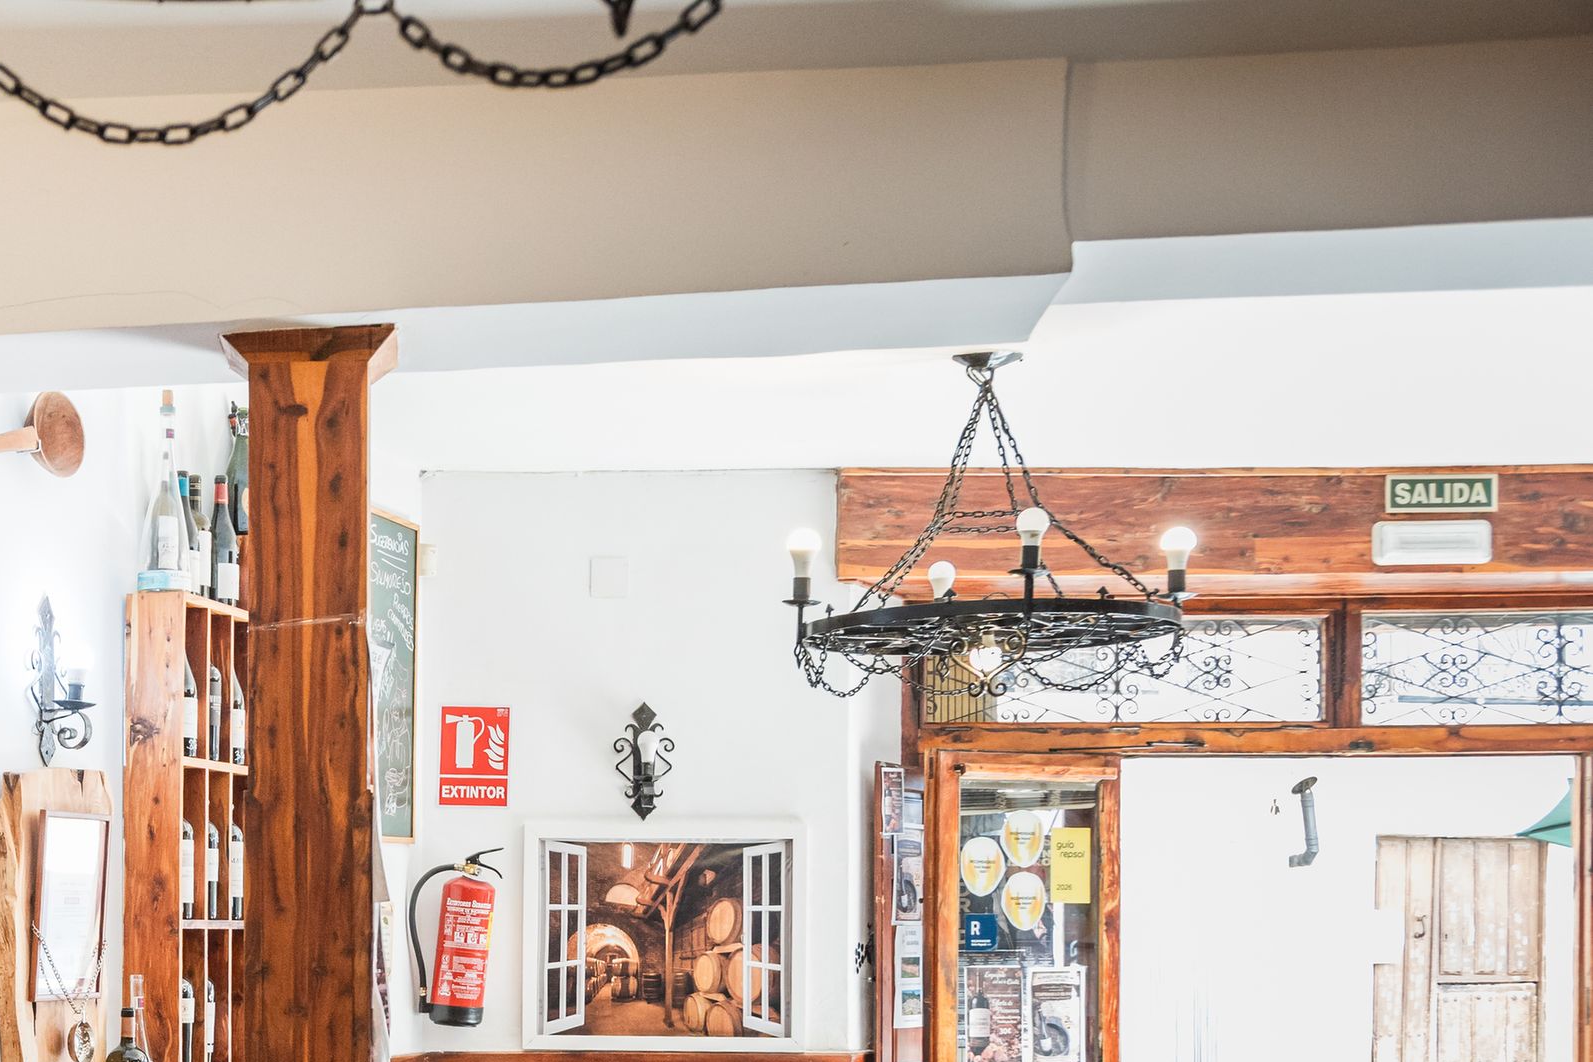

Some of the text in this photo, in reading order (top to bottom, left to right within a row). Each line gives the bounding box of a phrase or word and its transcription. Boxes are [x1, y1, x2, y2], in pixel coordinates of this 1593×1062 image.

[1394, 482, 1488, 504] SALIDA
[441, 785, 505, 799] EXTINTOR
[970, 920, 981, 936] R
